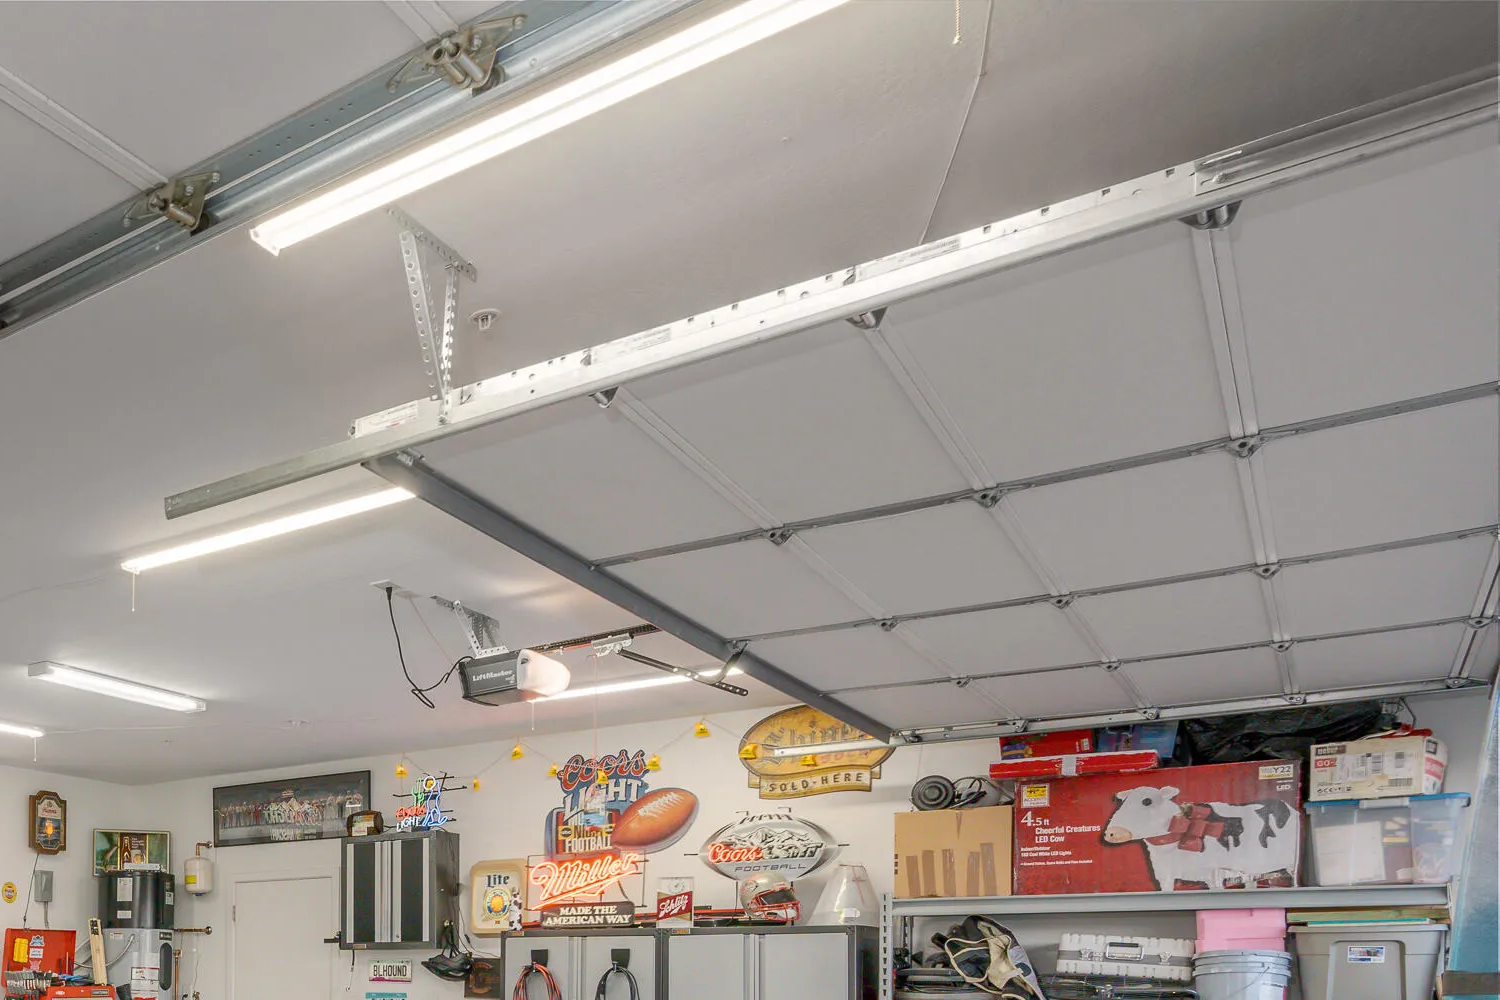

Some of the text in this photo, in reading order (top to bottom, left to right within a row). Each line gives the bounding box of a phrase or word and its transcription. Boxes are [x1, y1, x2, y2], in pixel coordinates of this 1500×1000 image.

[473, 670, 513, 681] LiftMaster
[558, 750, 646, 791] Coors
[396, 816, 422, 832] LIGHT
[1021, 811, 1043, 827] 4.5
[1035, 825, 1101, 835] Cheerful Creatures
[565, 835, 613, 853] FOOTBALL
[1035, 835, 1065, 844] LED Cow
[708, 843, 763, 864] Coors
[735, 863, 807, 873] FOOTBALL
[486, 874, 510, 888] Lite
[529, 852, 639, 902] Miller
[560, 904, 618, 916] MADE THE
[658, 894, 689, 919] Schlitz
[545, 914, 632, 926] AMERICAN WAY
[373, 964, 408, 977] BLHOUND
